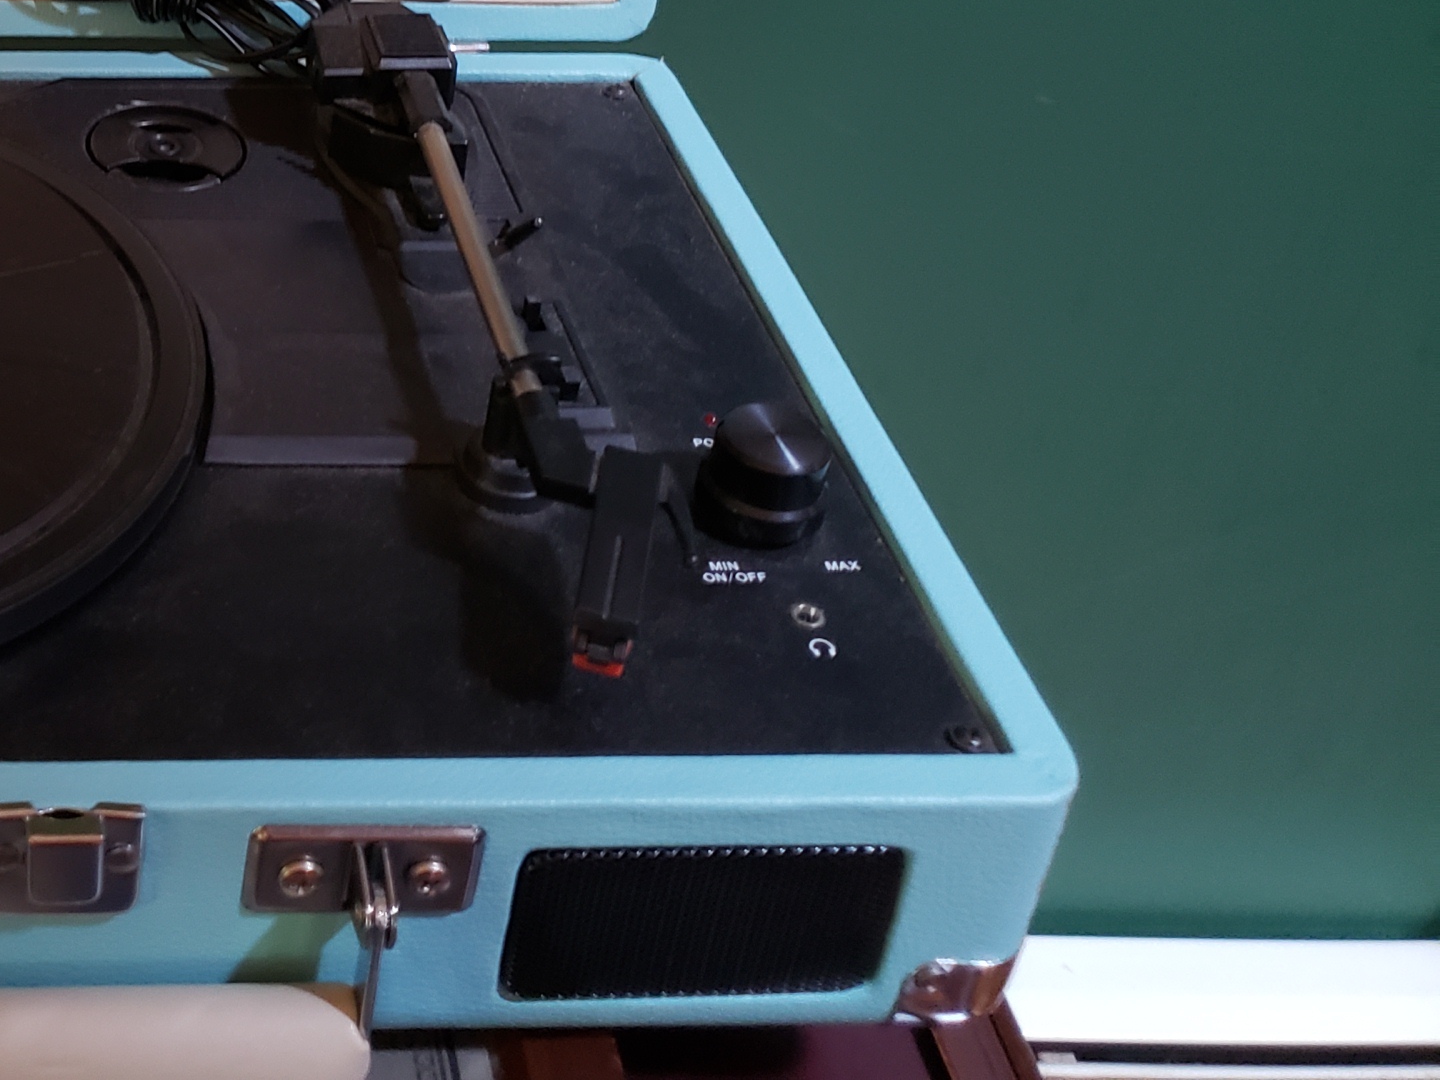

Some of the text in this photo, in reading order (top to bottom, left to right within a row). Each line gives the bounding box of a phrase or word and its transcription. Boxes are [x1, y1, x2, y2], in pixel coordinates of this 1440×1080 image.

[692, 437, 715, 449] PO
[708, 560, 739, 571] MIN
[824, 560, 861, 571] MAX
[702, 571, 767, 584] ON/OFF
